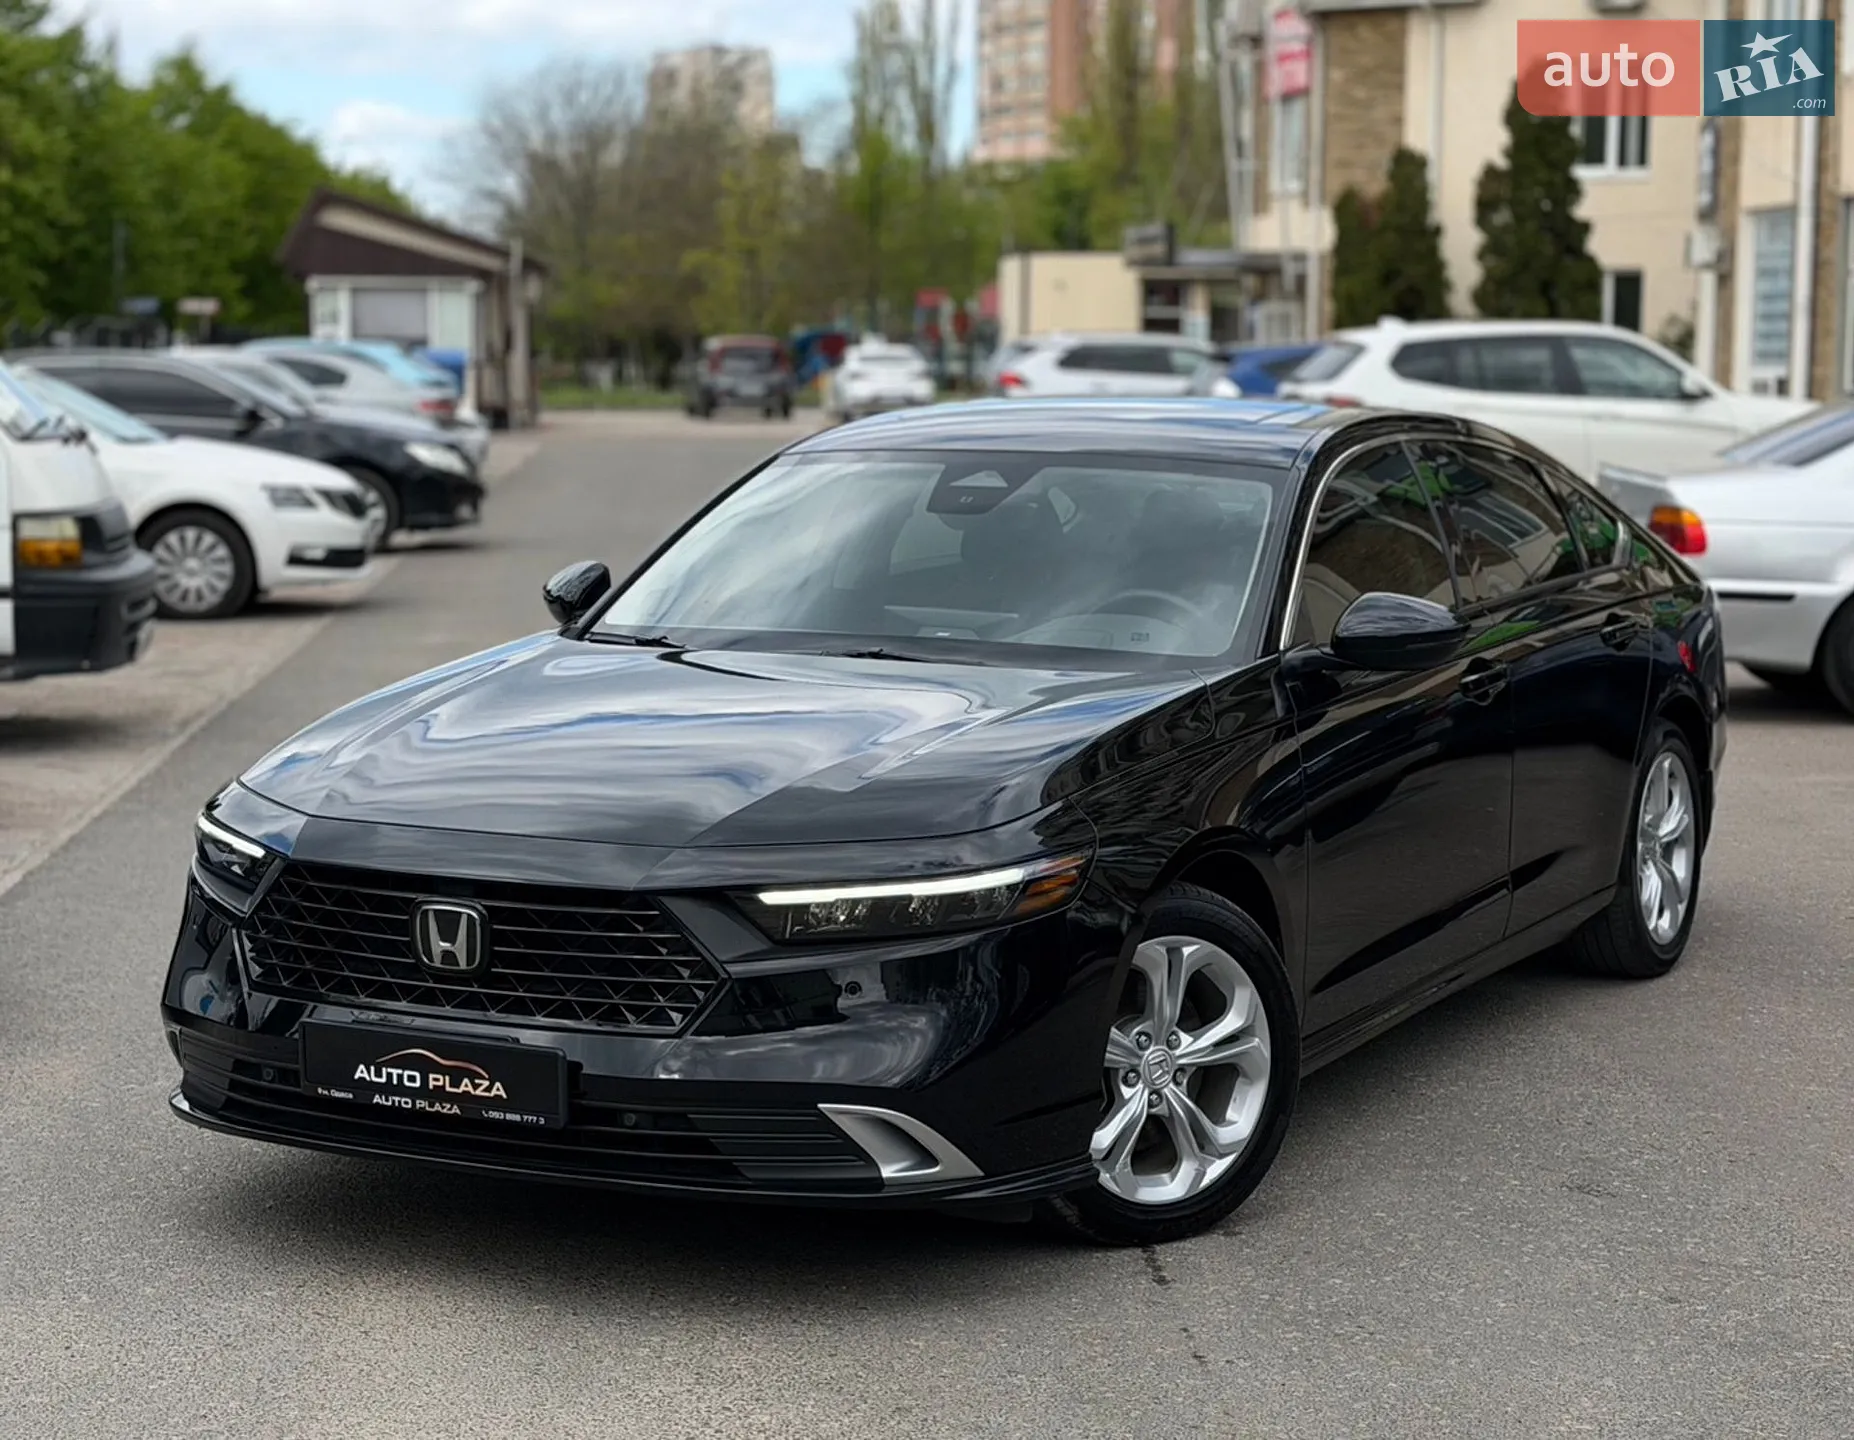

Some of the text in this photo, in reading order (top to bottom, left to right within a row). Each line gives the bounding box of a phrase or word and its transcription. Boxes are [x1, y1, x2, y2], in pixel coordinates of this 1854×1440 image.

[354, 1063, 508, 1099] AUTO PLAZA
[372, 1094, 461, 1115] AUTO PLAZA
